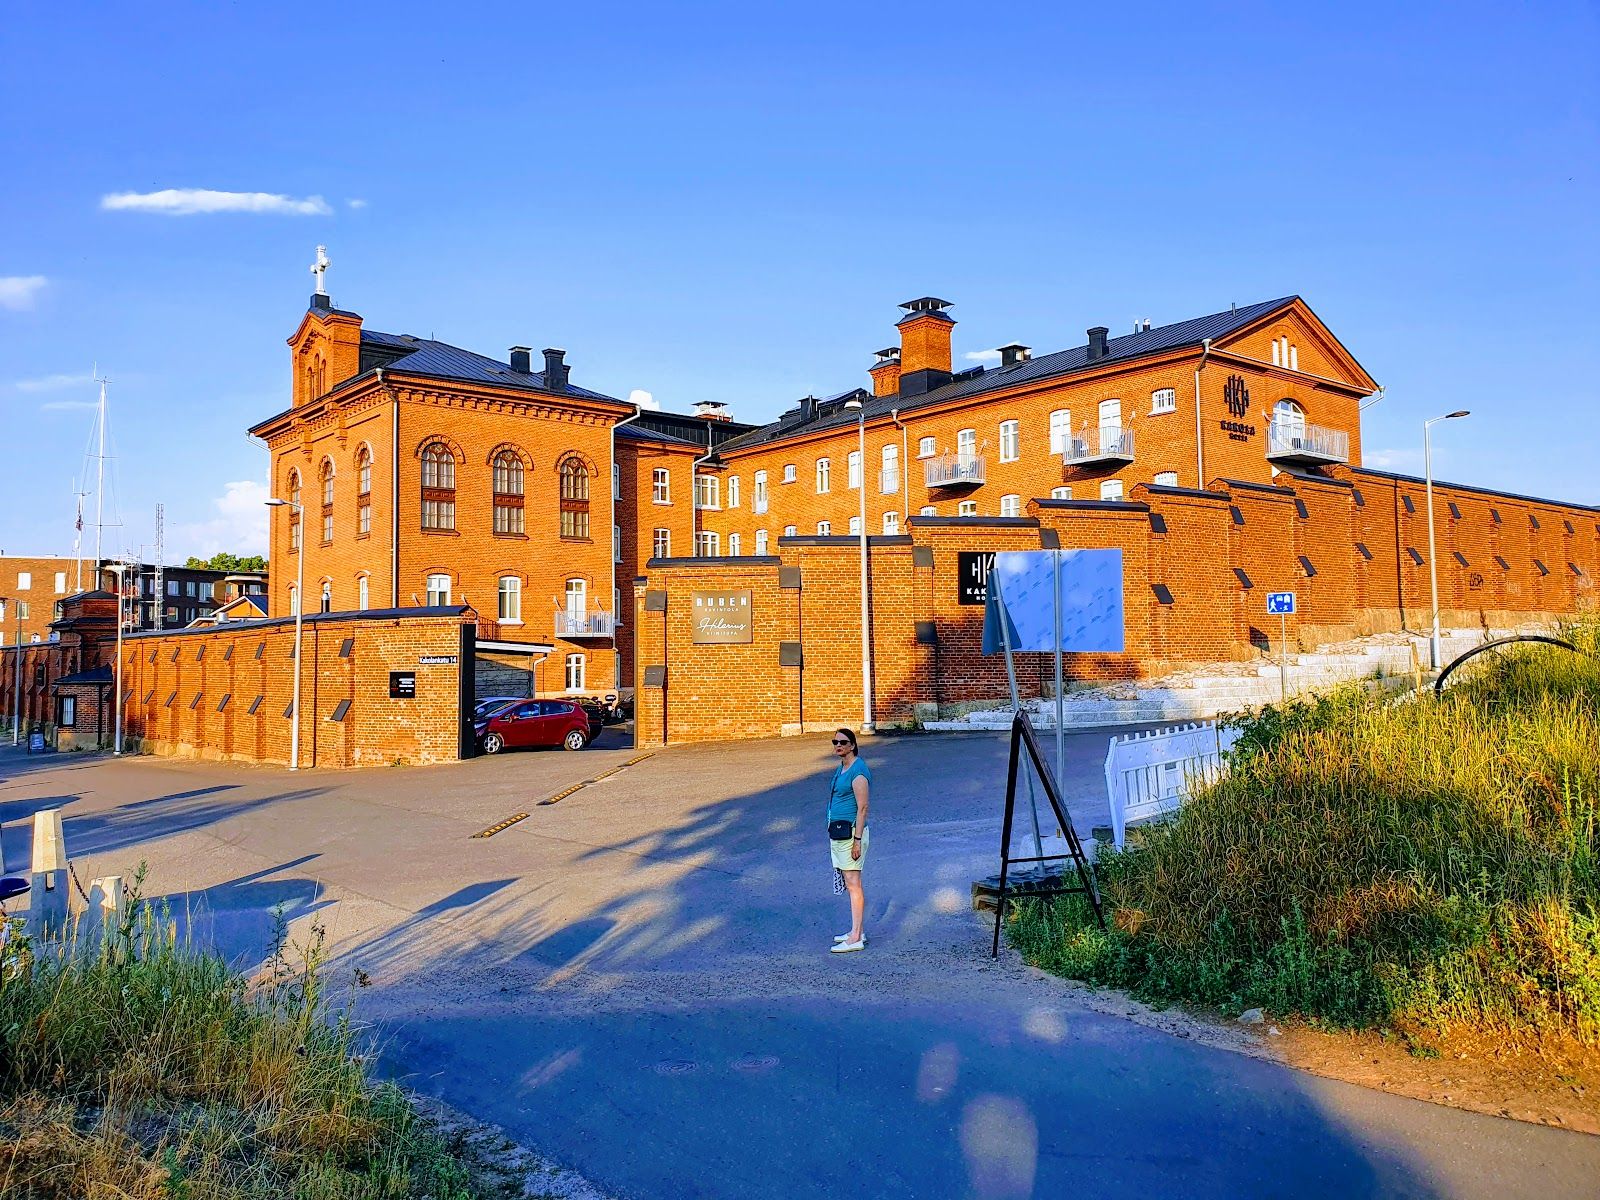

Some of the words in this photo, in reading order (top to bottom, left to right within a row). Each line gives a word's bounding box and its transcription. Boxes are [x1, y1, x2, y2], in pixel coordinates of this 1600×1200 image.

[966, 587, 987, 595] KAK
[696, 597, 747, 606] RUBEN
[696, 617, 746, 632] Hilarius
[450, 656, 457, 664] 14
